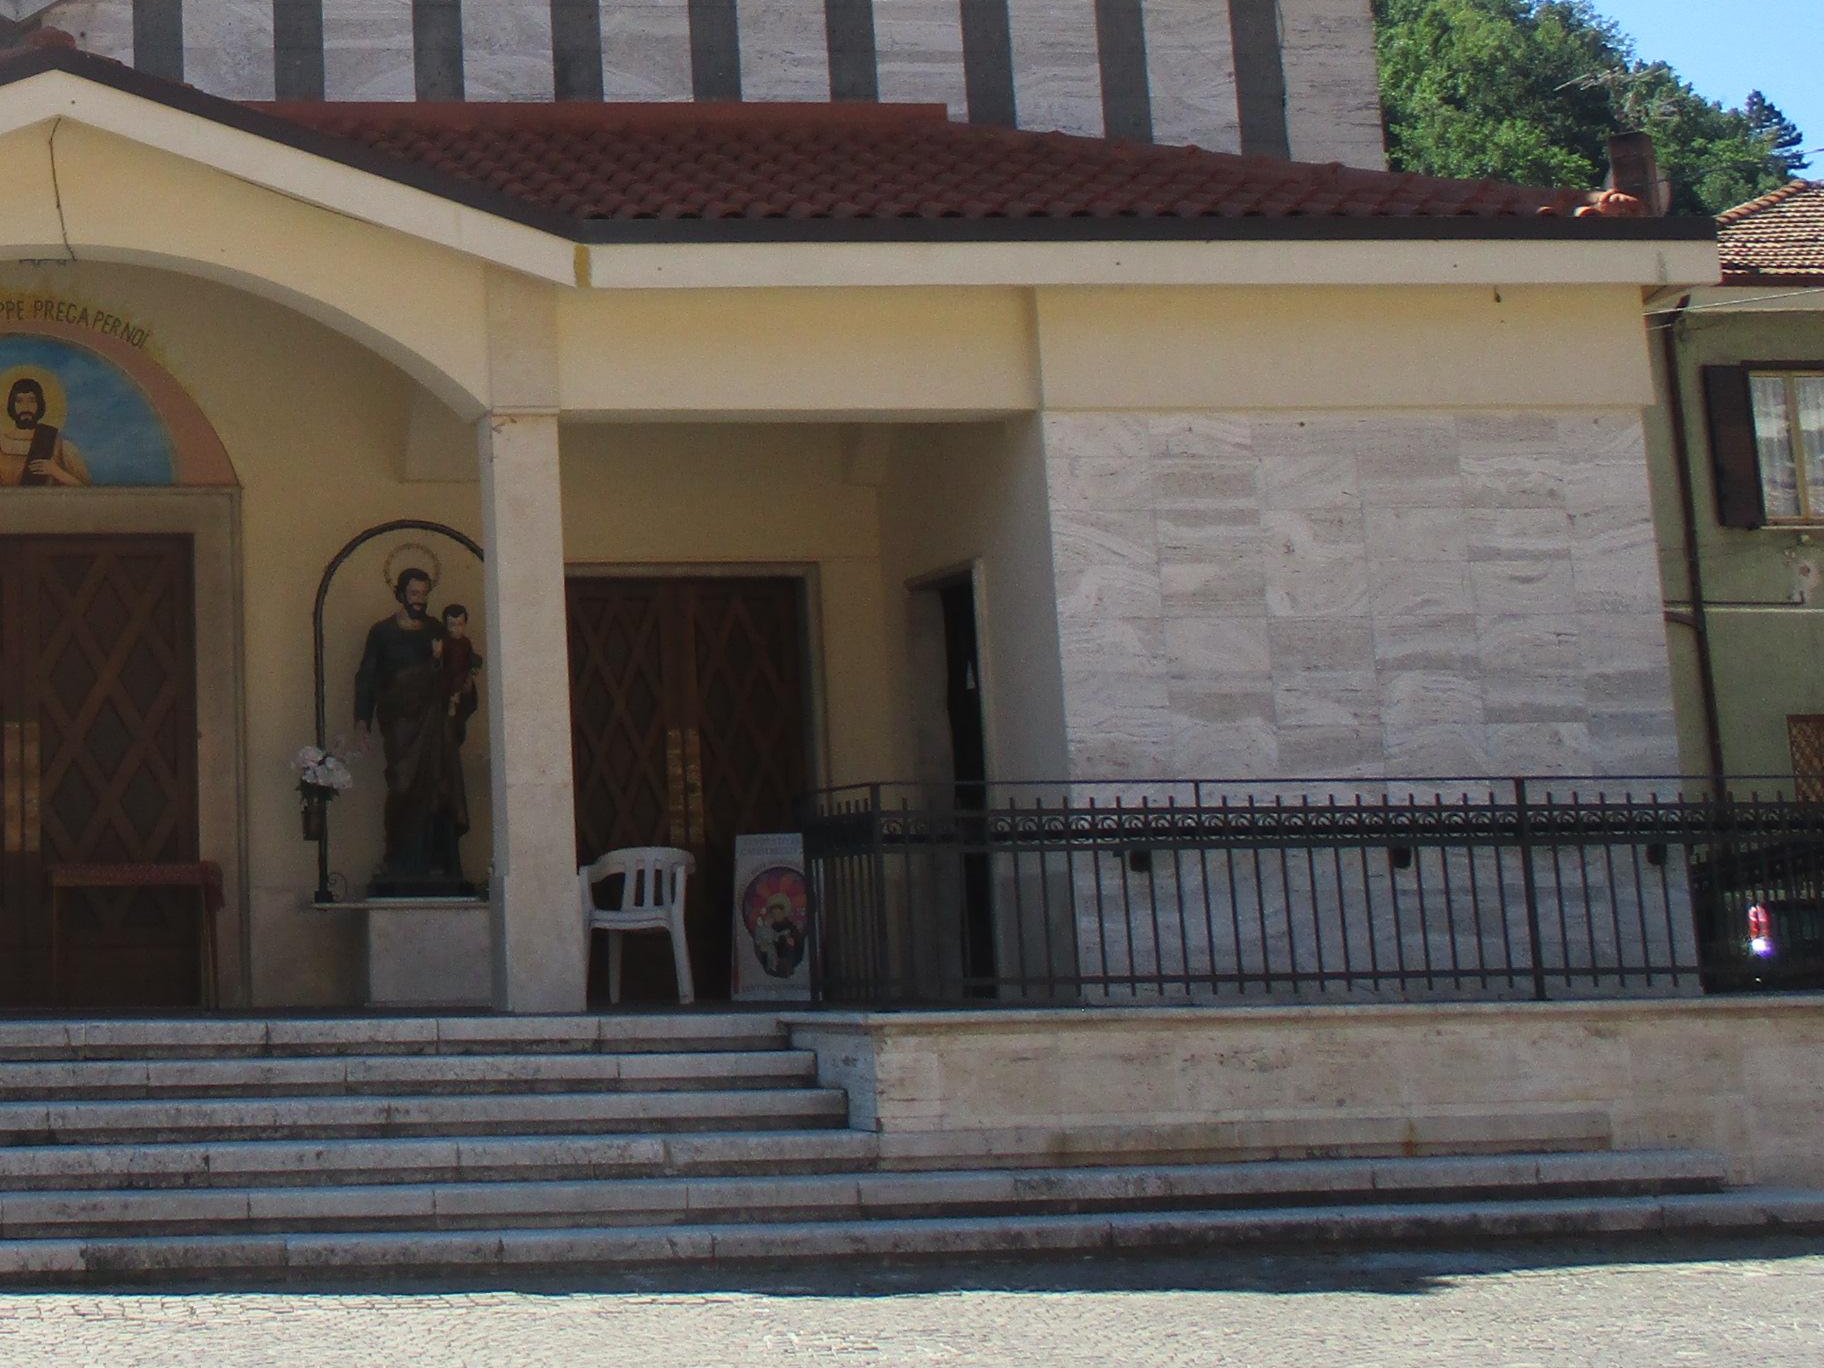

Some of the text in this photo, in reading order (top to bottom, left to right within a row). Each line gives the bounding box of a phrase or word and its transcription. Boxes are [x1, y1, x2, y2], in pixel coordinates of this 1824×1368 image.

[32, 299, 89, 328] PREGA
[91, 309, 122, 335] PER
[119, 320, 151, 350] NOI
